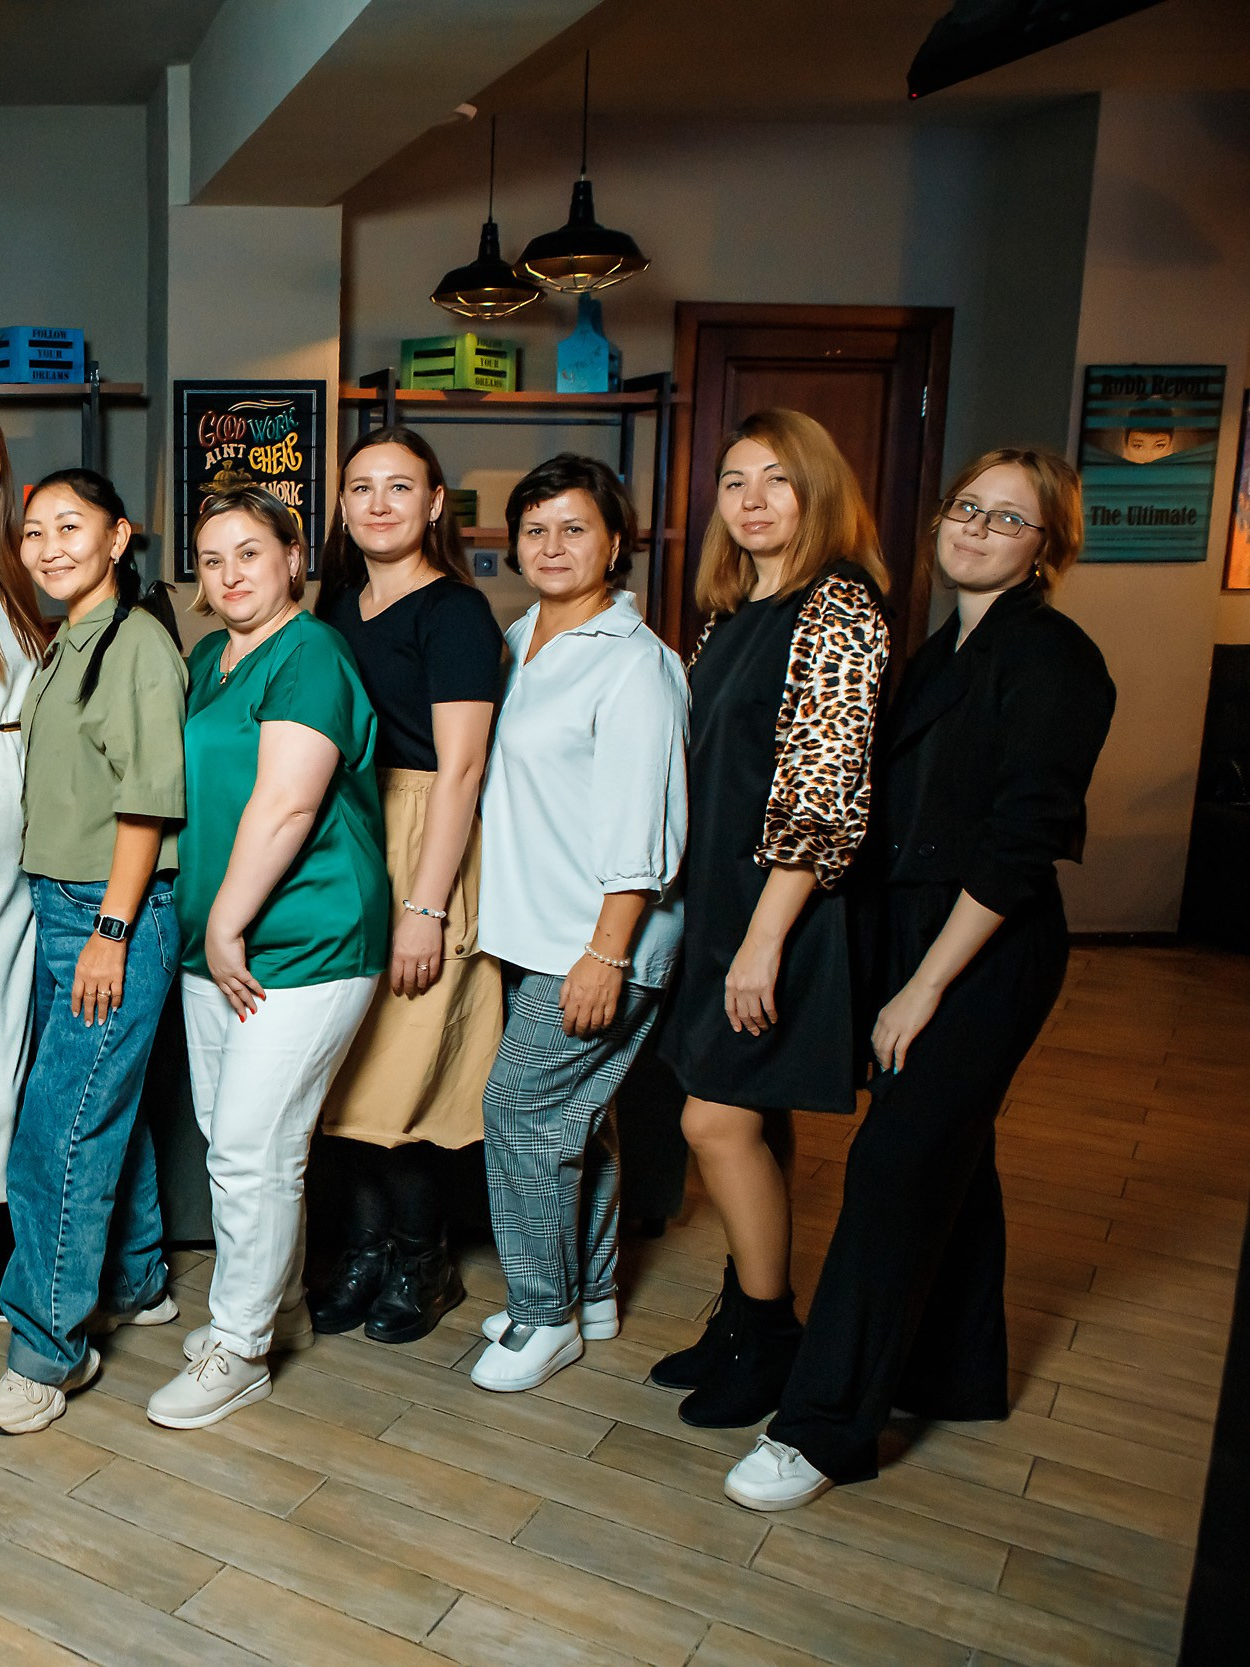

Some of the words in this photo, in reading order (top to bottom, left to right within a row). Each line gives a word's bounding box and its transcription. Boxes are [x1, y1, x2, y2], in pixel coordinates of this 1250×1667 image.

[32, 329, 67, 339] FOLLOW
[38, 349, 62, 359] YOUR
[480, 357, 499, 369] YOUR
[32, 371, 69, 380] DREAMS
[198, 411, 247, 448] GOOD
[247, 407, 299, 442] WORK
[248, 431, 303, 475] CHEAP
[1090, 506, 1121, 526] The
[1126, 506, 1197, 526] Ultimate
